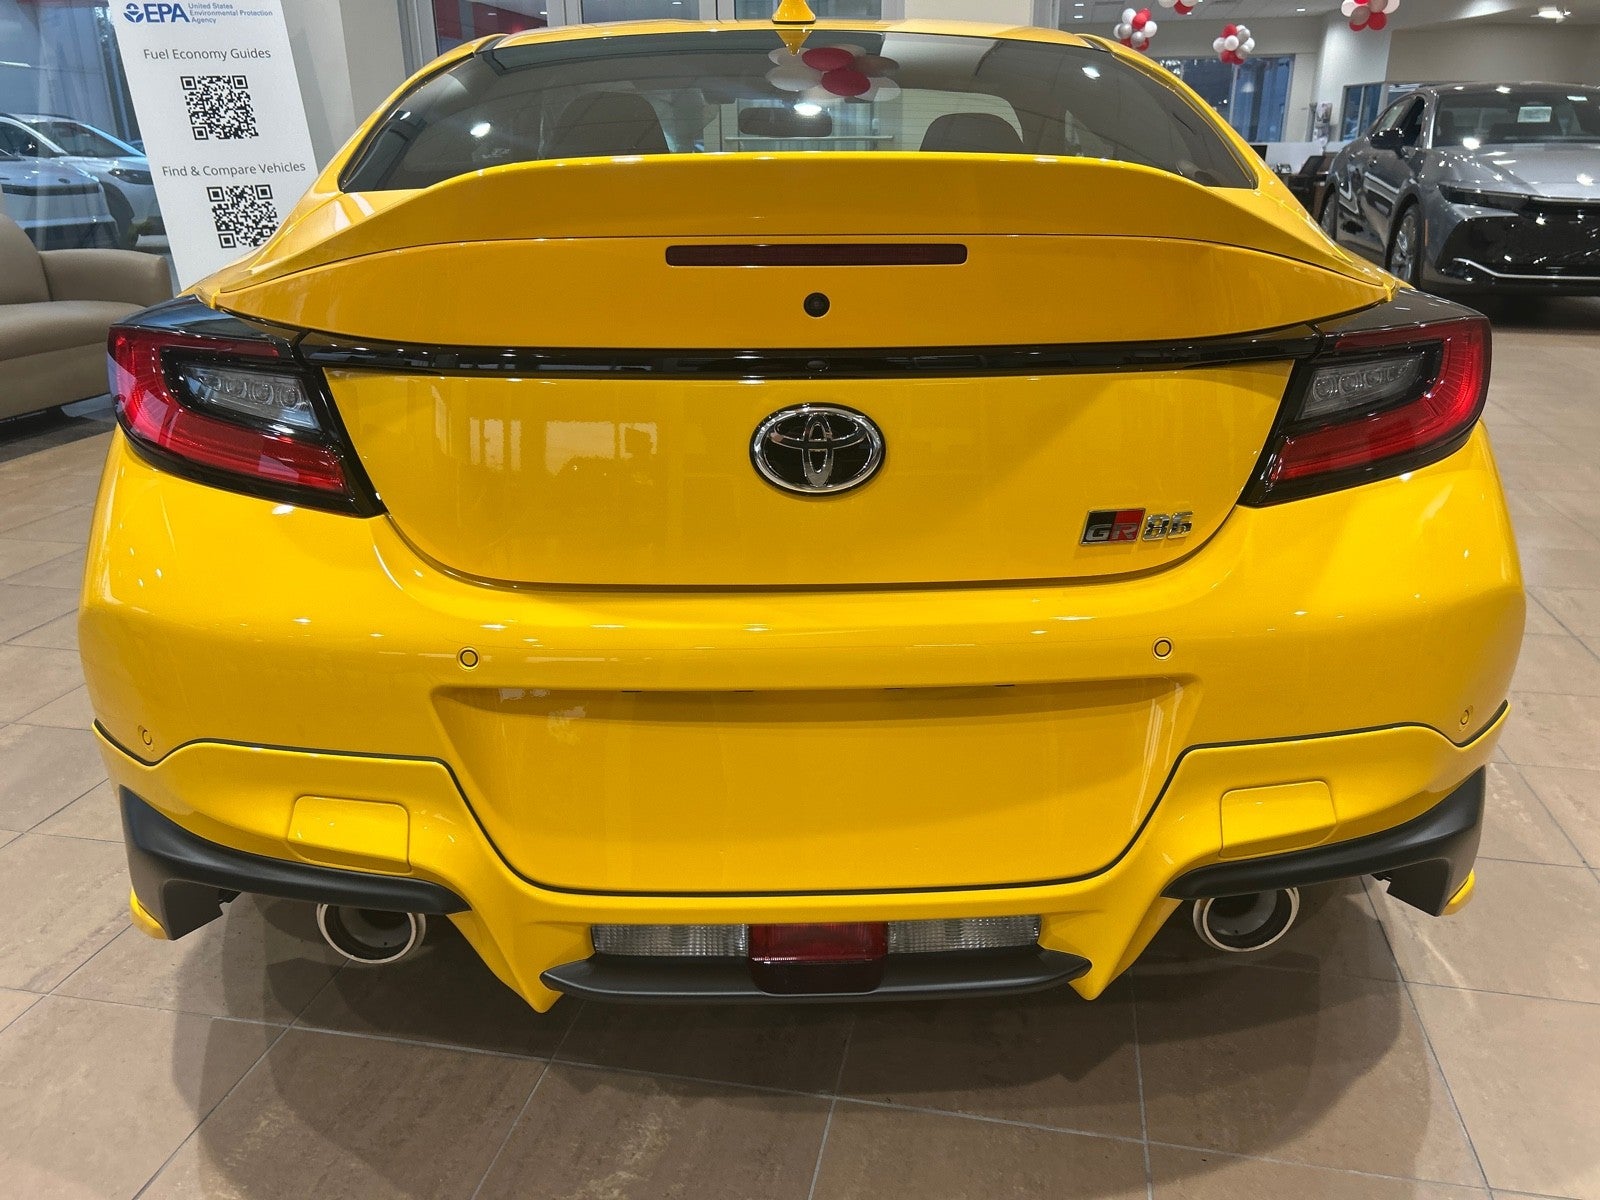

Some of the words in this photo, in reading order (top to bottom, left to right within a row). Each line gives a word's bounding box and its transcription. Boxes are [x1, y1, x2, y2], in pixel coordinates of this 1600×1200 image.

[143, 3, 190, 23] EPA
[143, 48, 169, 60] Fuel
[172, 49, 227, 62] Economy
[230, 48, 272, 59] Guides
[162, 165, 188, 177] Find
[190, 165, 200, 176] &
[203, 164, 256, 177] Compare
[258, 161, 306, 174] Vehicles
[1086, 523, 1138, 541] GR
[1143, 511, 1193, 541] 86
